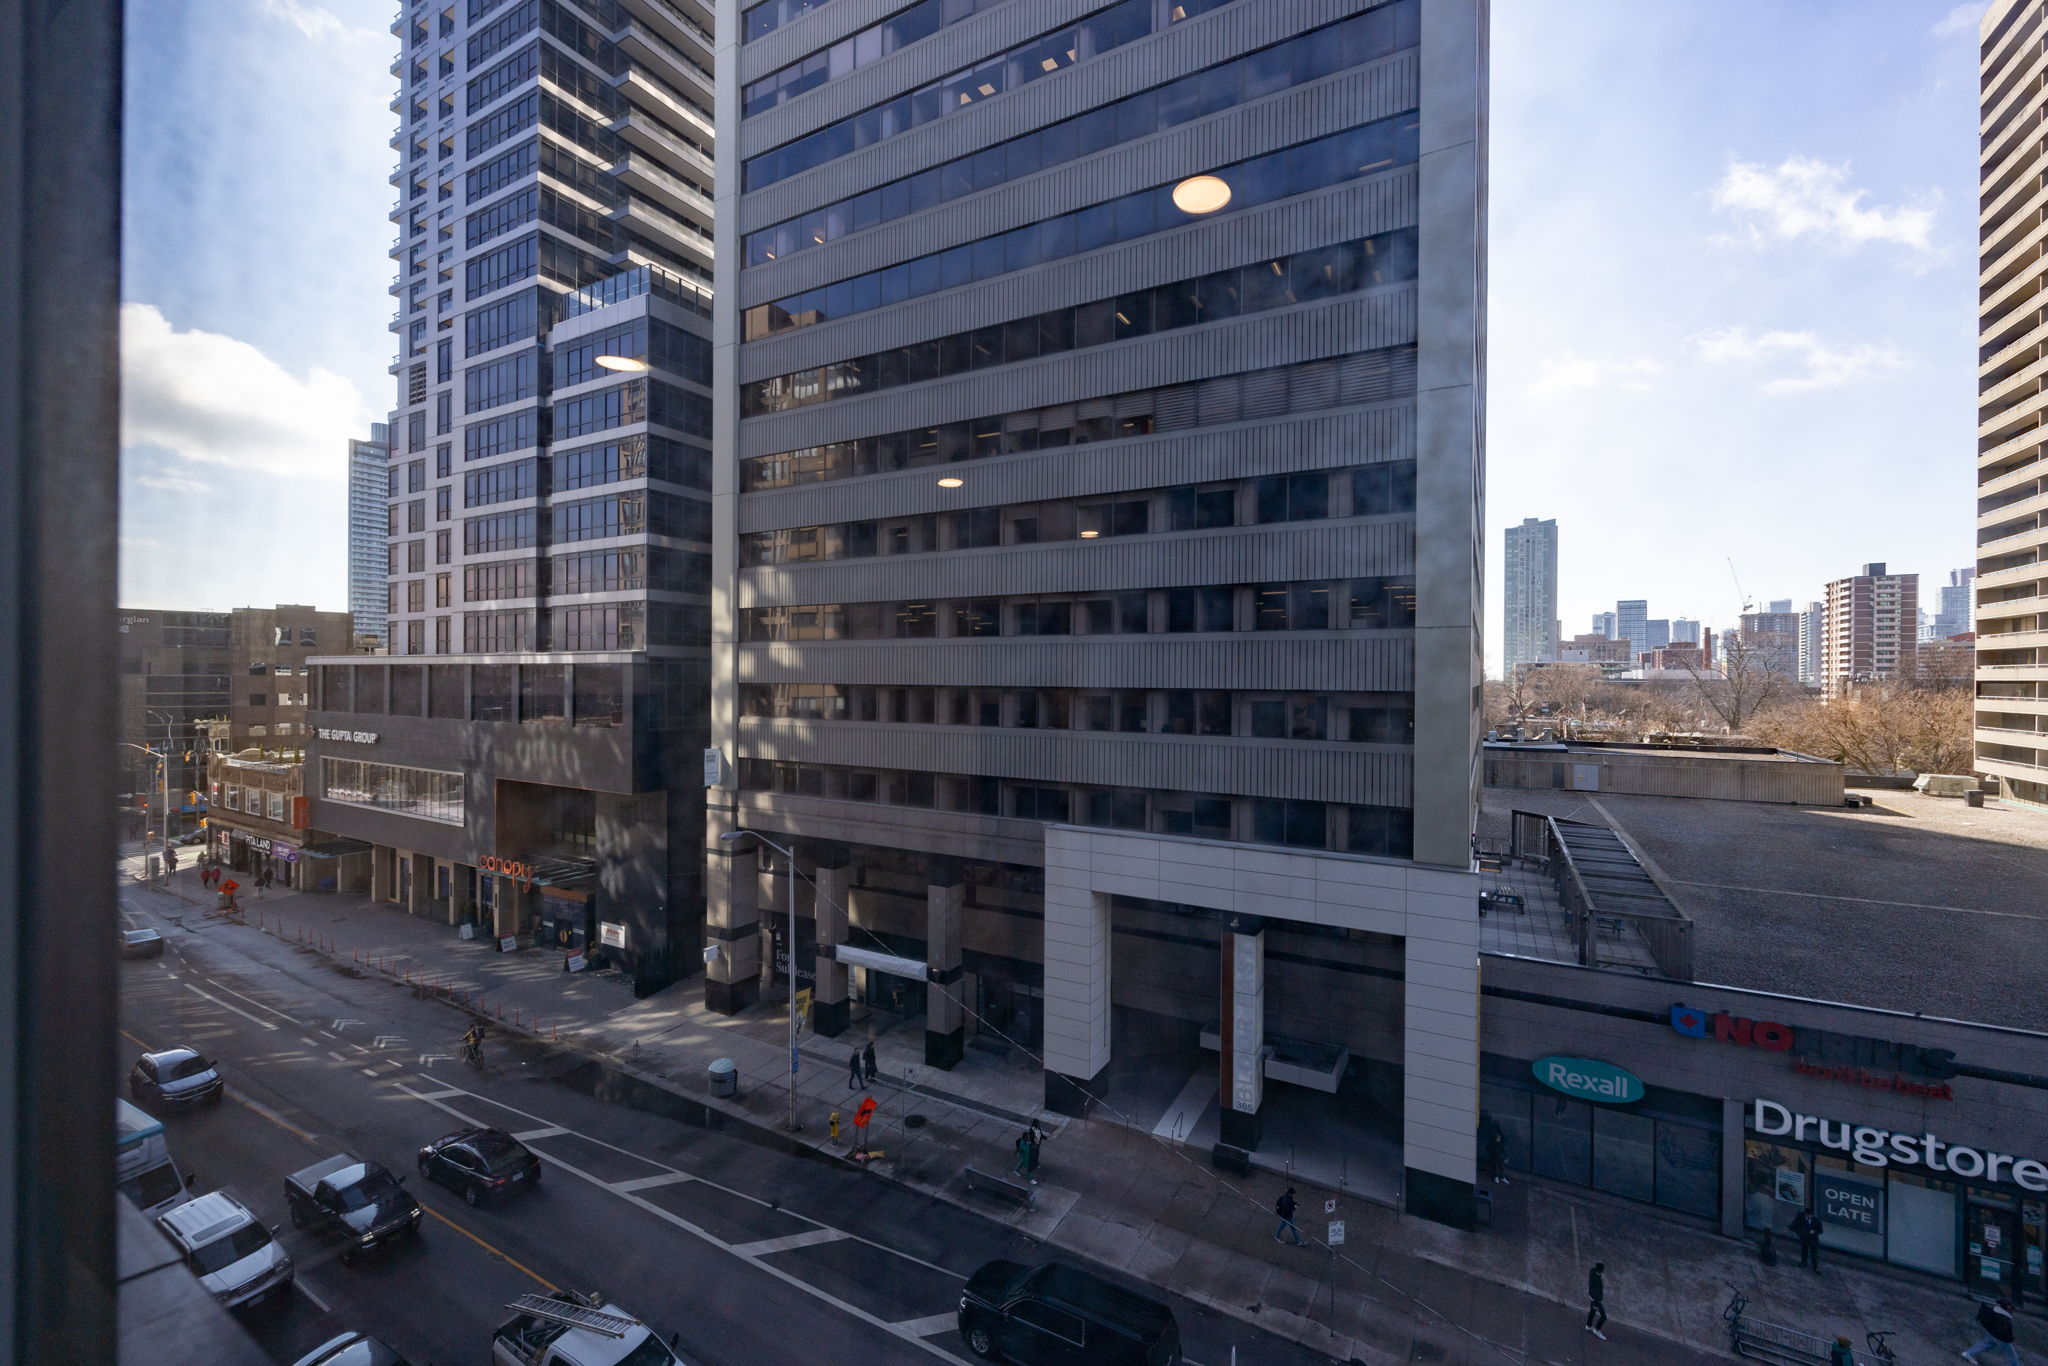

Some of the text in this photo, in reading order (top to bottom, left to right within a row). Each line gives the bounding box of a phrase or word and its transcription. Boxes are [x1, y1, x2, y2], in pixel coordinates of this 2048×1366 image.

[318, 728, 377, 744] THE GUPTA GROUP
[246, 834, 271, 850] PITA LAND
[479, 854, 532, 894] canopy
[1714, 1013, 1795, 1052] NO
[1236, 1019, 1254, 1102] BLOOR
[1548, 1062, 1628, 1098] Rexall
[1859, 1067, 1891, 1091] be
[1895, 1072, 1953, 1101] beat
[1236, 1100, 1254, 1112] 365
[1755, 1098, 2048, 1192] Drugstore
[1824, 1187, 1875, 1209] OPEN
[1827, 1203, 1872, 1225] LATE
